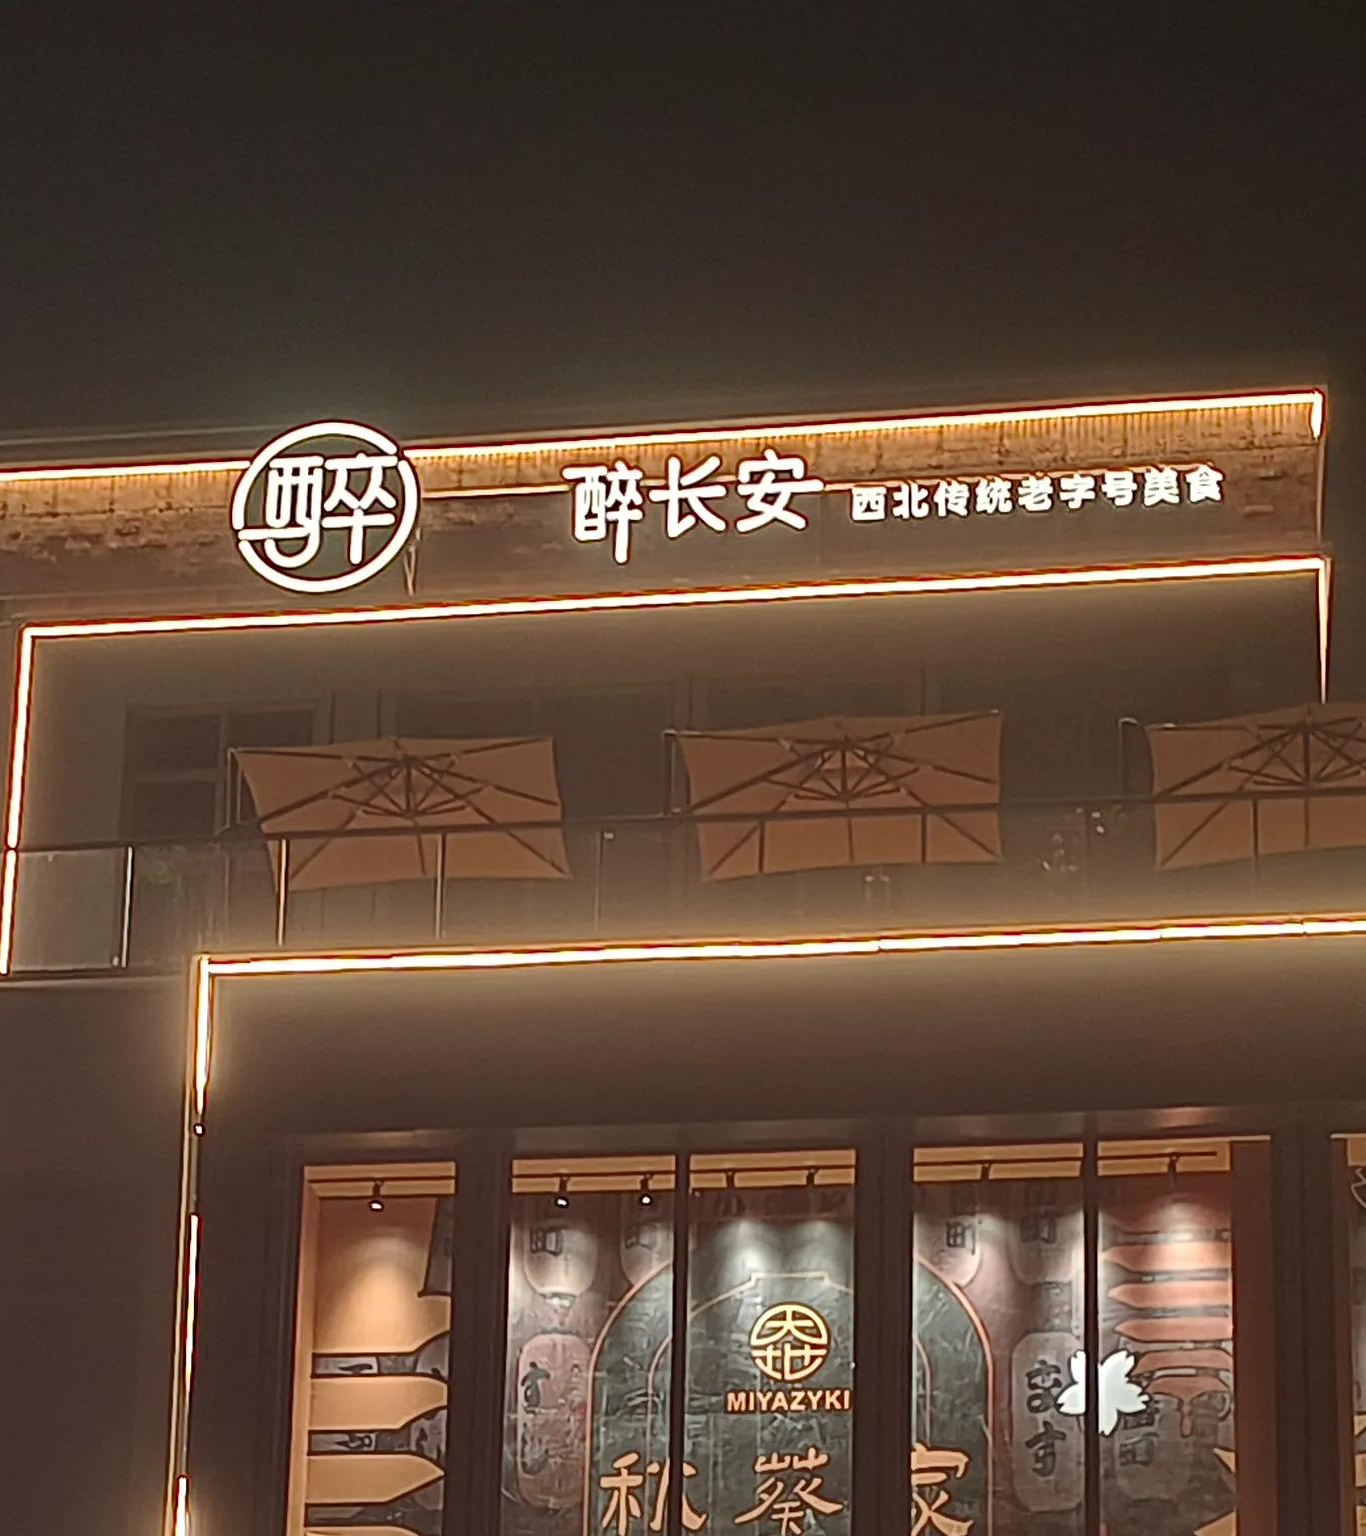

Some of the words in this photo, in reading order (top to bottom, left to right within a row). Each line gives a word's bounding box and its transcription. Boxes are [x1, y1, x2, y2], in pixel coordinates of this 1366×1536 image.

[562, 448, 825, 564] 醉长安
[850, 461, 1225, 522] 西北传统老字号美食
[726, 1389, 852, 1413] MIYAZYKI
